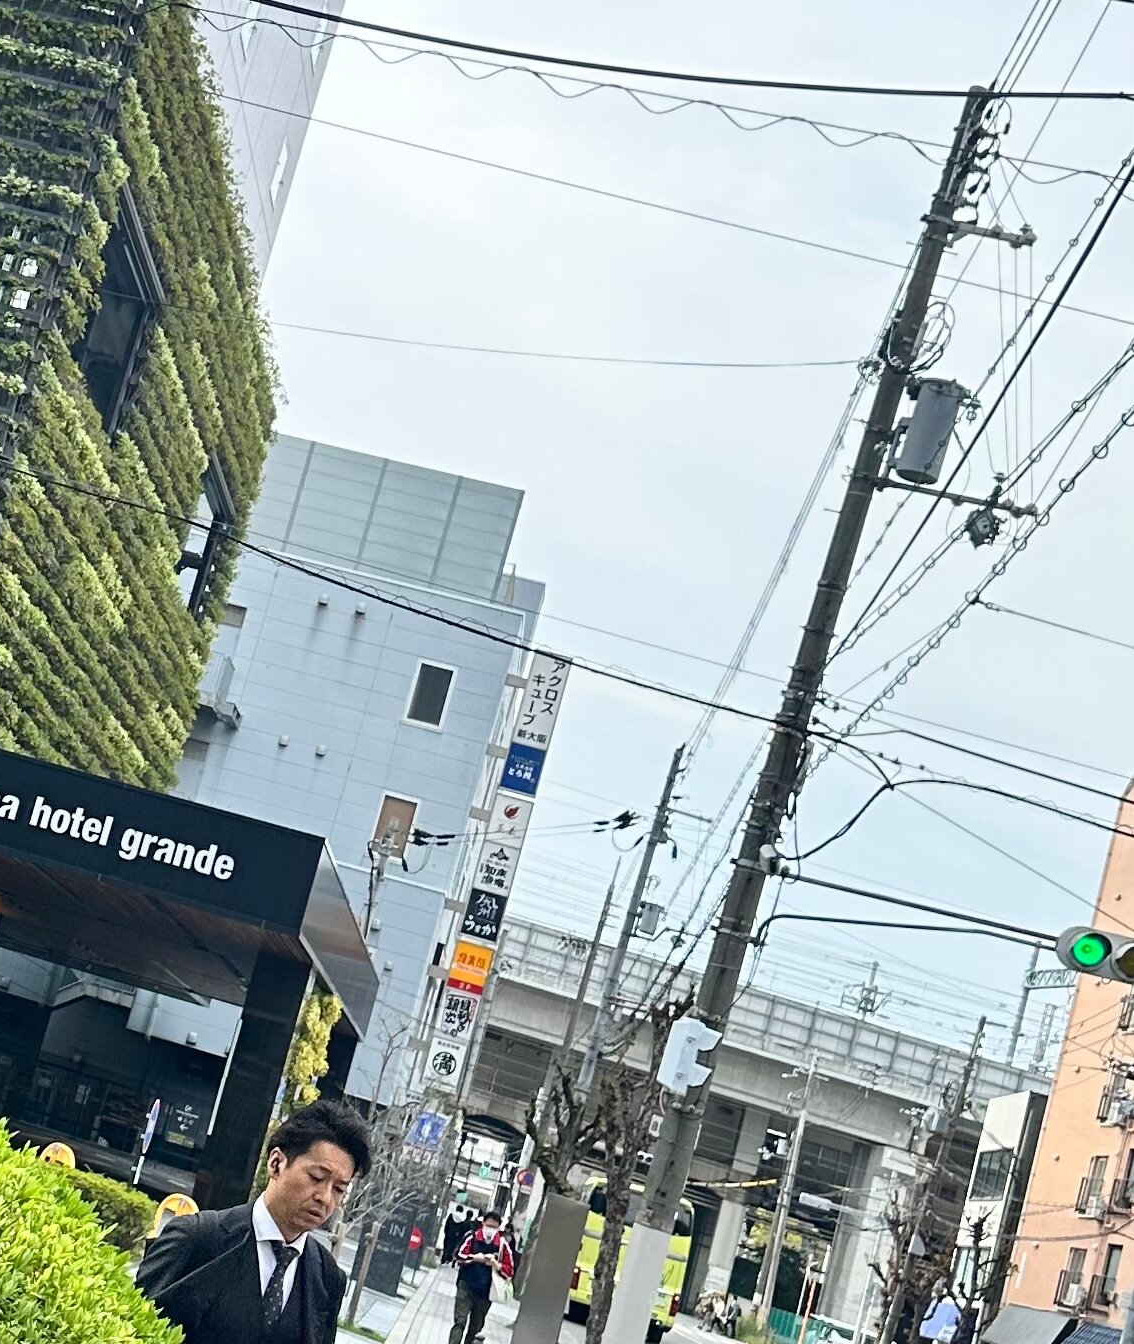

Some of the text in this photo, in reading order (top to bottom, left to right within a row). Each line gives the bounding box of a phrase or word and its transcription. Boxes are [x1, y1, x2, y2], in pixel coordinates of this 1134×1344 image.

[522, 674, 546, 726] キューブ
[540, 661, 565, 715] アクロス
[517, 729, 548, 744] 新大阪
[29, 797, 114, 846] hotel
[119, 827, 235, 880] grande
[389, 1223, 406, 1238] IN
